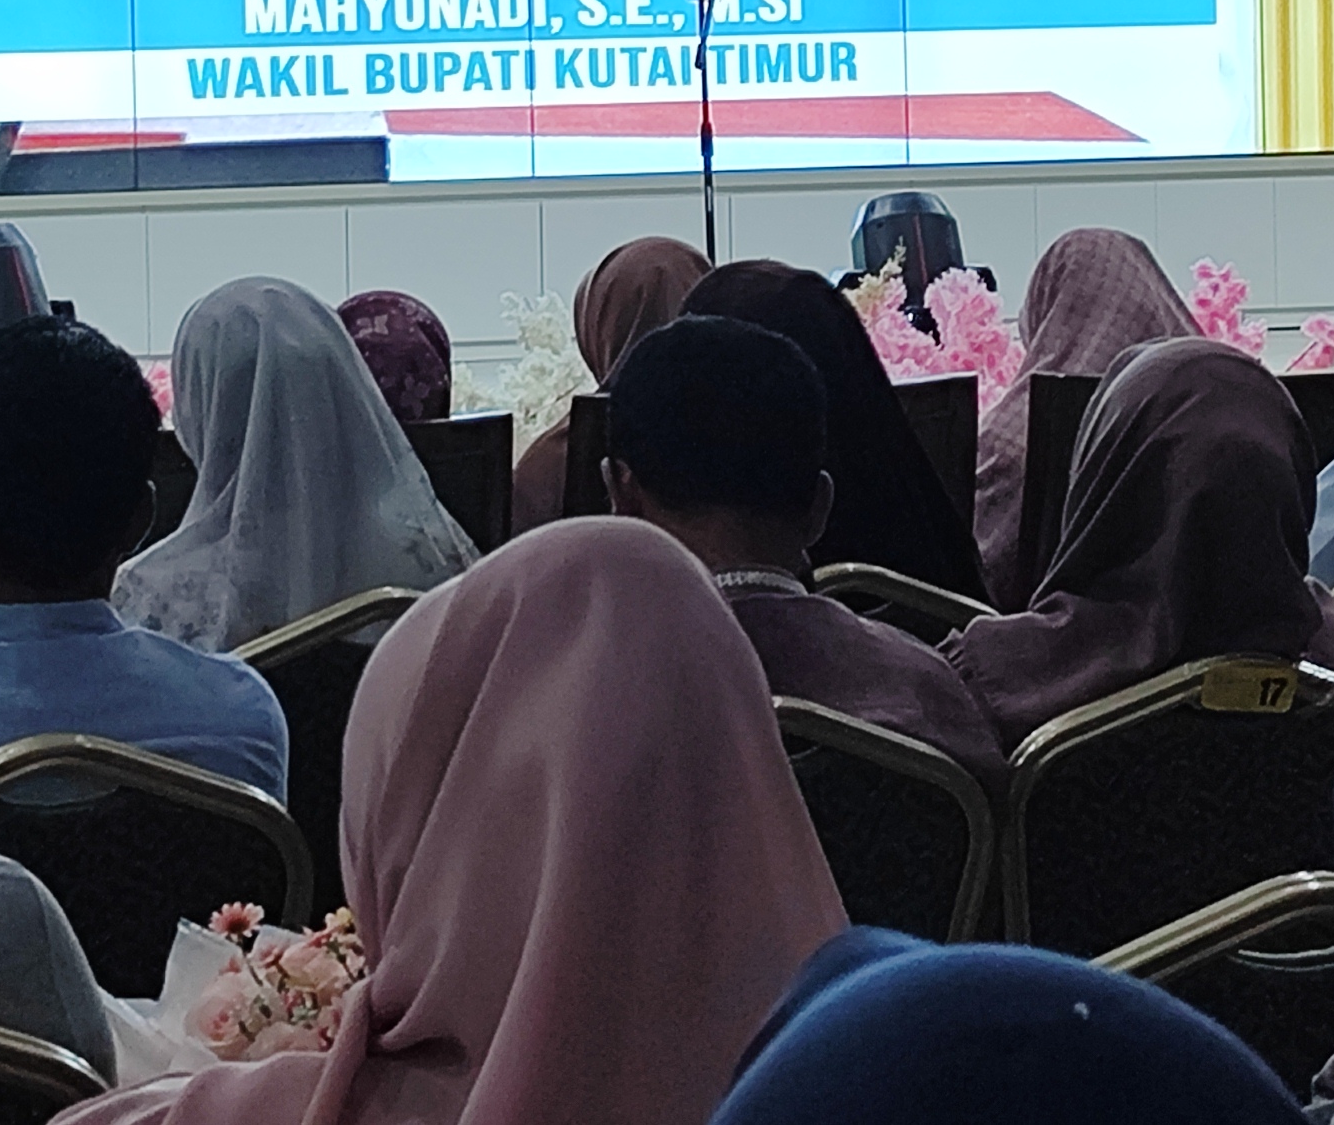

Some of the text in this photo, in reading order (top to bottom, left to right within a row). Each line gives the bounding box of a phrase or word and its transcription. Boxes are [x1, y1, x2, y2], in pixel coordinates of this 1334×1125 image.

[186, 41, 858, 100] WAKIL BUPATI KUTAI TIMUR
[1258, 677, 1289, 707] 17
